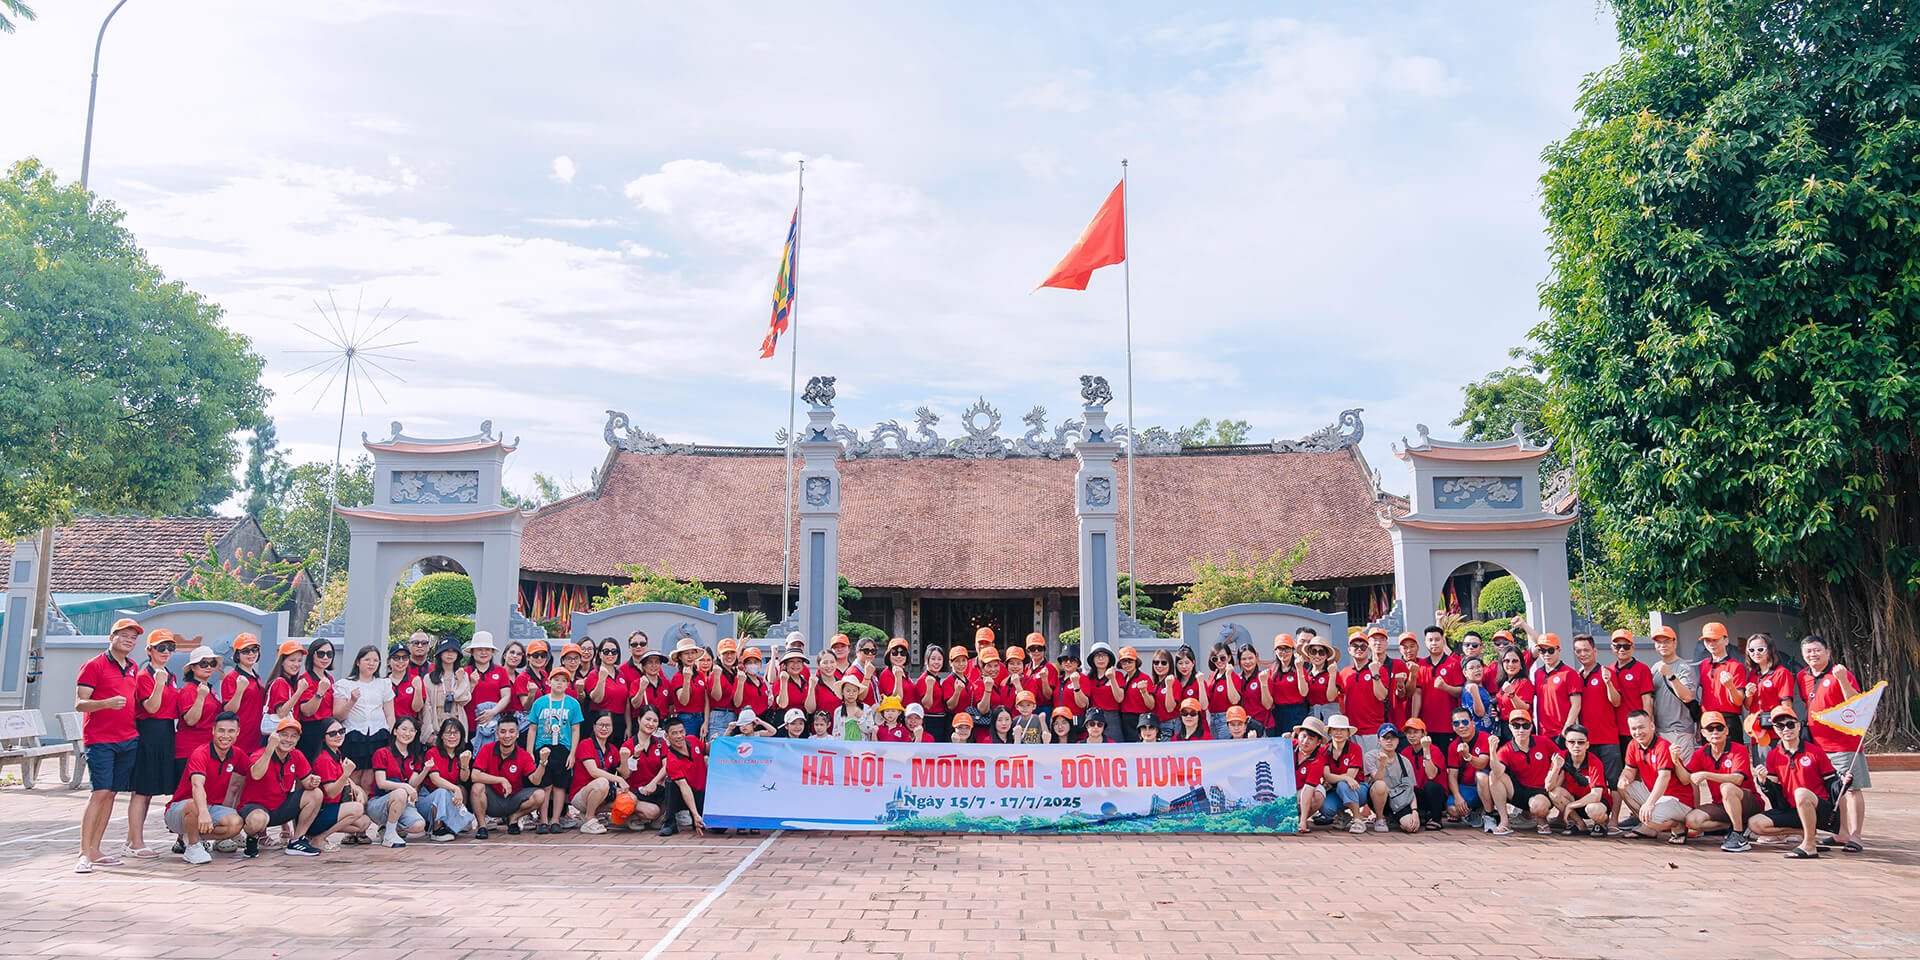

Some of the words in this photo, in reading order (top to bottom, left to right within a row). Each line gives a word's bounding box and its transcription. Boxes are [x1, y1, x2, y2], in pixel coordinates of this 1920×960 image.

[802, 750, 837, 786] HÀ
[843, 752, 884, 793] NỘI
[911, 754, 986, 788] MÓNG
[994, 754, 1034, 789] CÁI
[1061, 754, 1128, 789] ĐÔNG
[1136, 755, 1202, 788] HƯNG
[903, 794, 944, 810] Ngày
[950, 795, 986, 809] 15/7
[1000, 795, 1082, 809] 17/7/2025
